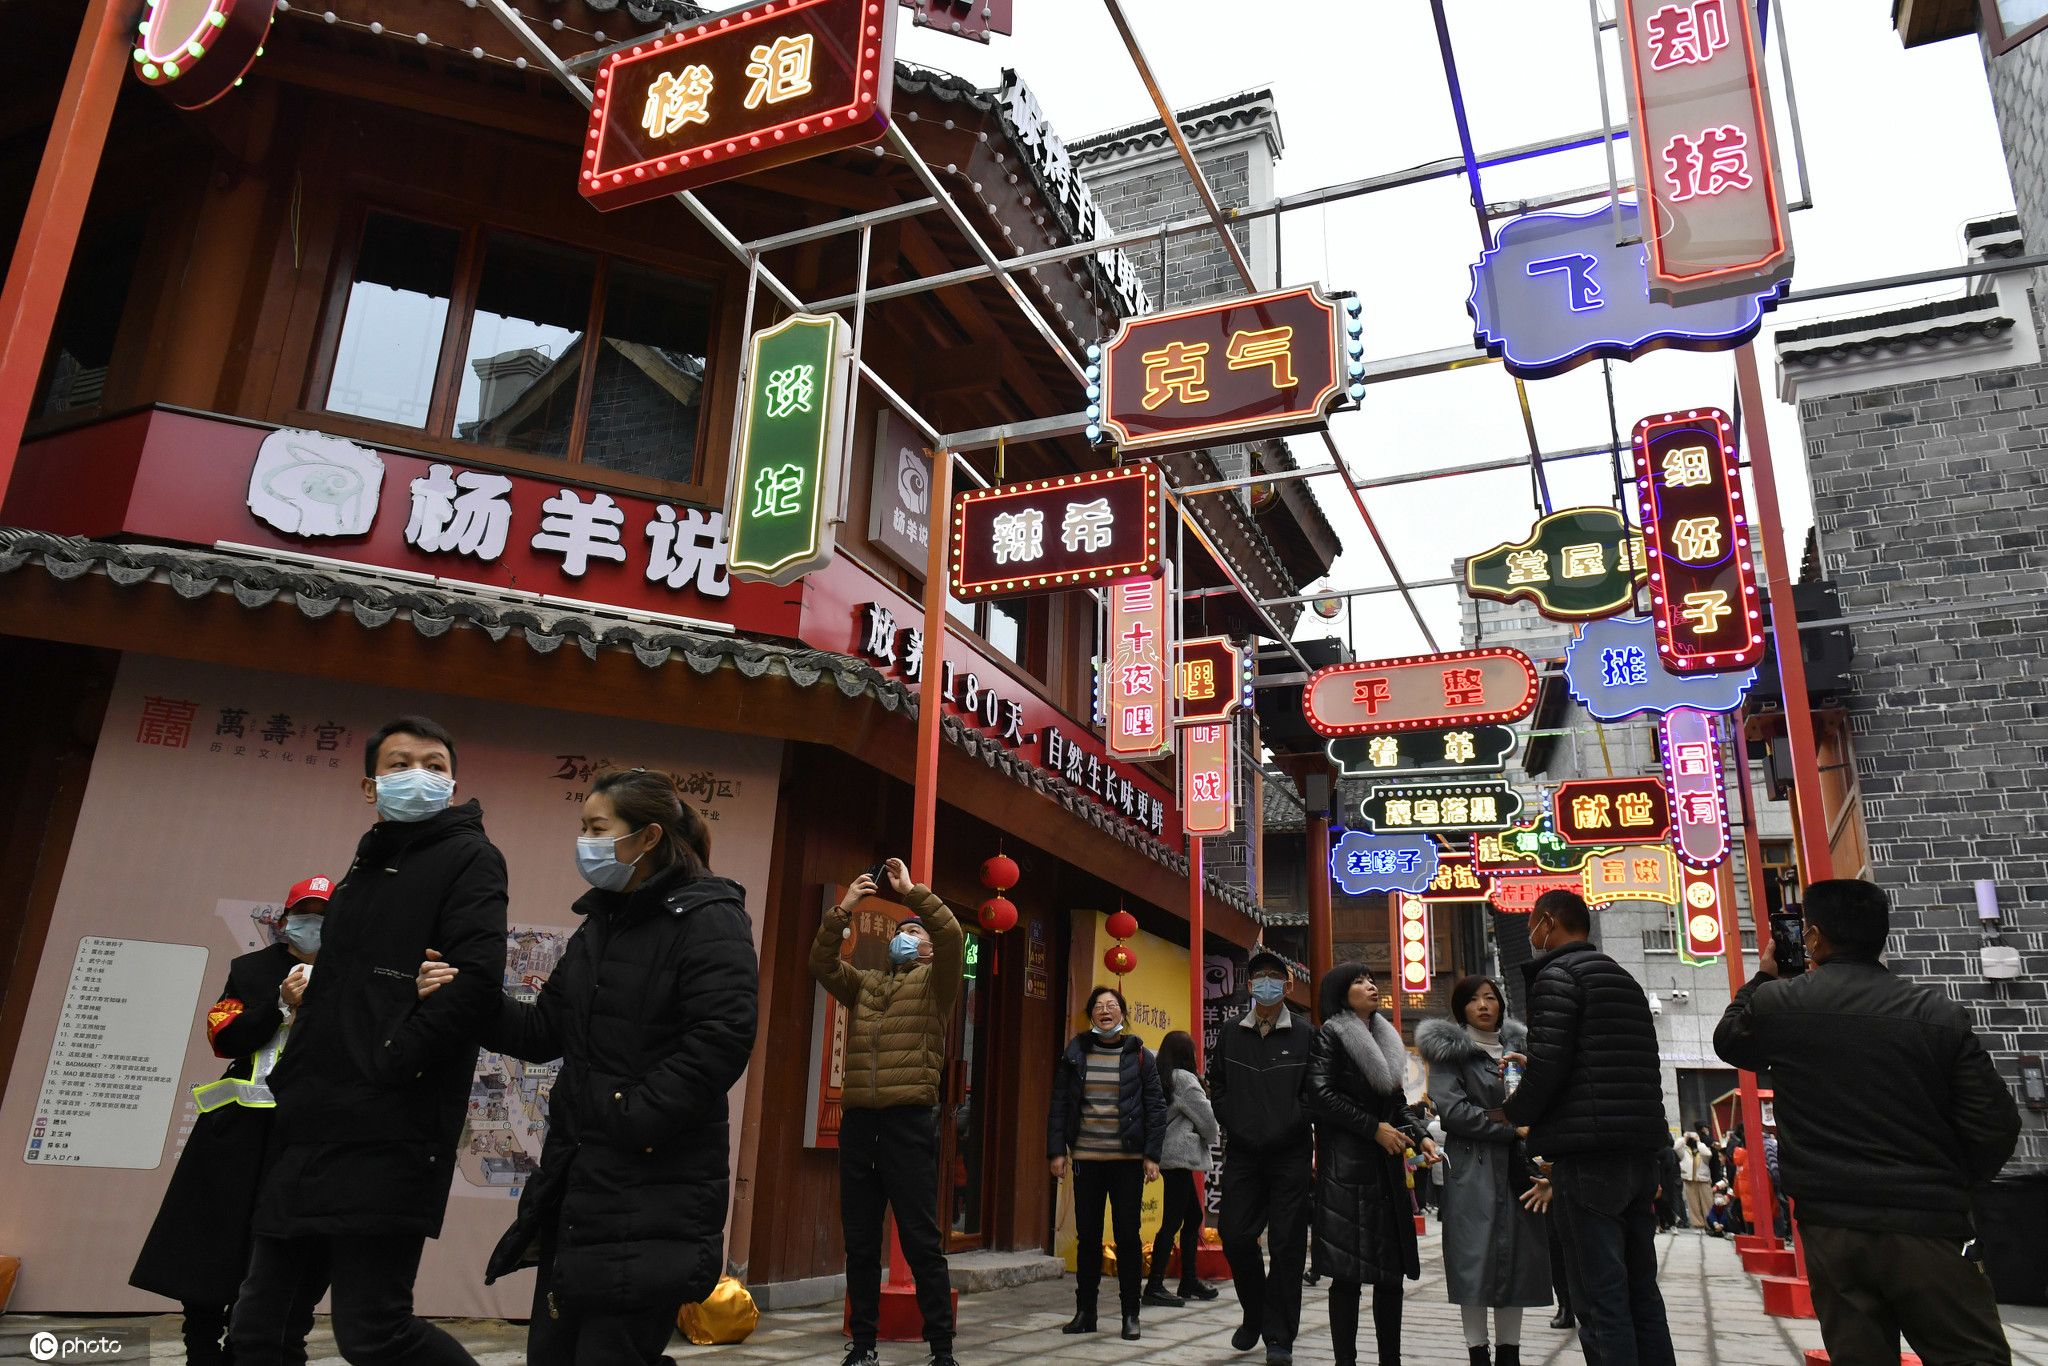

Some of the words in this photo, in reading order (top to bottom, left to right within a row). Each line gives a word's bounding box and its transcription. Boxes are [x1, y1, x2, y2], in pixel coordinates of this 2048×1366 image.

[1142, 326, 1298, 410] 克气
[752, 364, 814, 518] 谈坨
[404, 463, 731, 597] 杨羊说
[892, 506, 929, 548] 杨羊说
[992, 498, 1113, 564] 辣希
[1122, 583, 1154, 736] 三十夜哩
[1352, 667, 1486, 716] 平整
[565, 791, 590, 803] 2月
[1572, 792, 1654, 829] 献世
